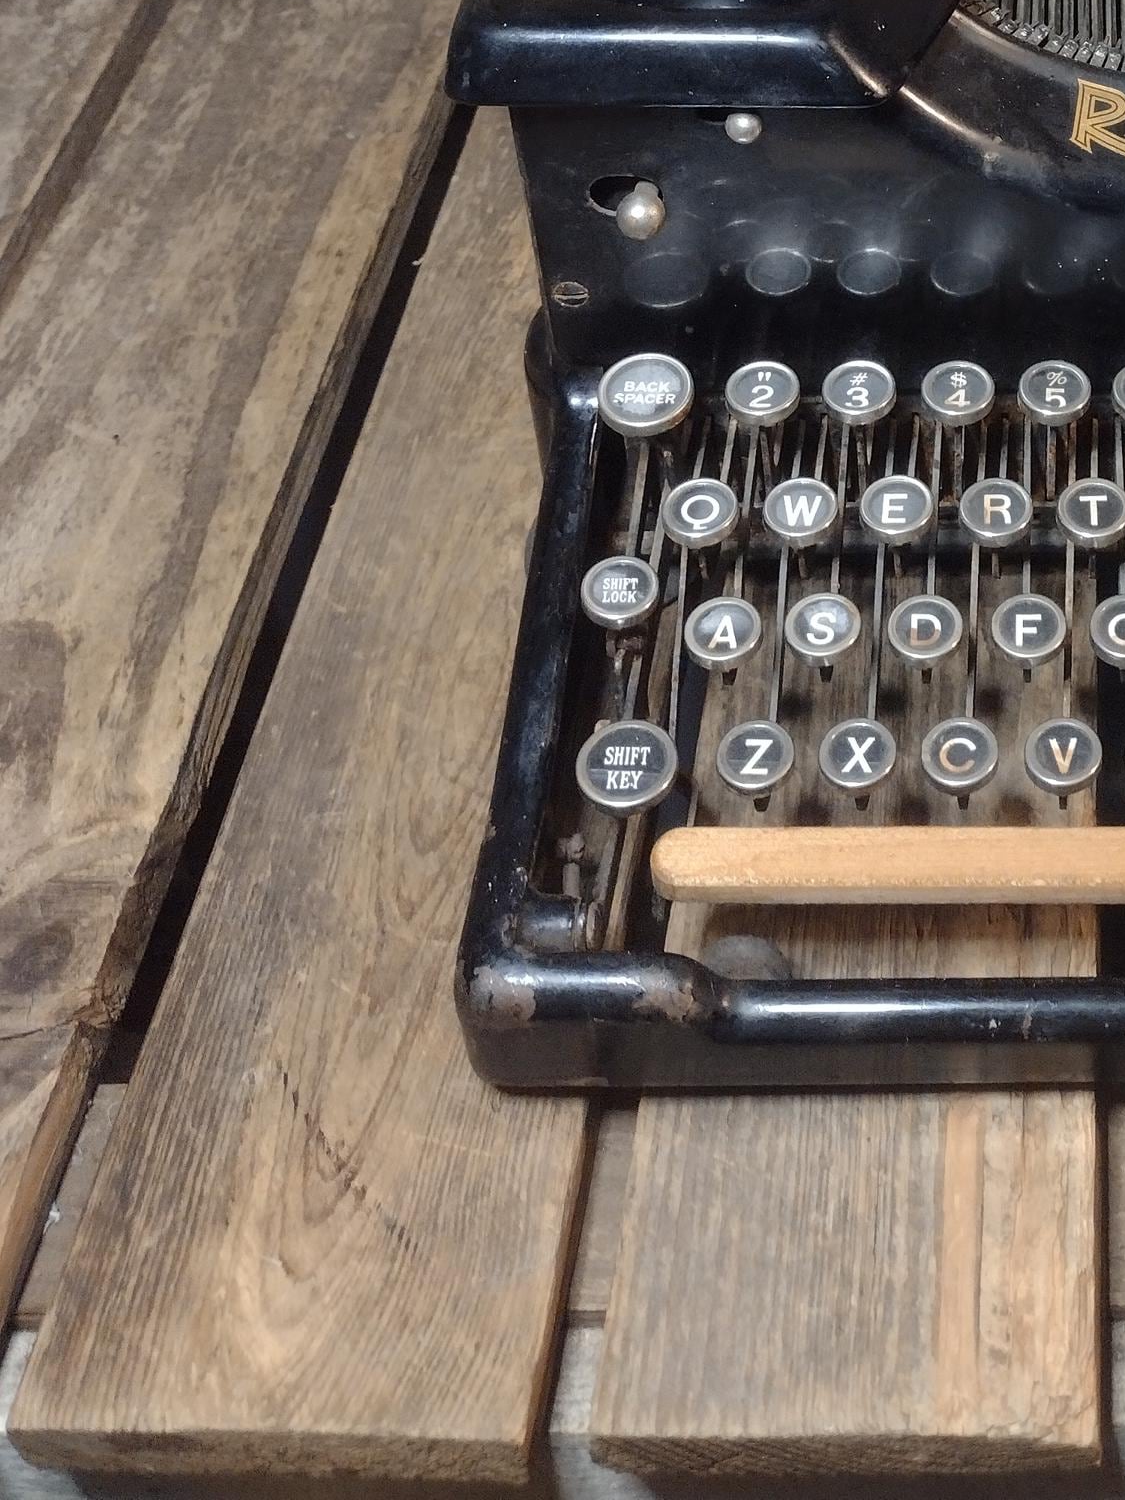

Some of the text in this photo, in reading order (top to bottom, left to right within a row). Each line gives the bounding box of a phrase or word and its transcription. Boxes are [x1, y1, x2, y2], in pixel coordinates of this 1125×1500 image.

[613, 392, 676, 405] SPACER
[624, 380, 670, 393] BACK
[749, 385, 775, 408] 2
[844, 387, 869, 407] 3
[944, 389, 971, 408] 4
[1045, 388, 1067, 408] 5
[681, 494, 720, 530] Q
[783, 495, 822, 526] W
[881, 493, 908, 524] E
[983, 494, 1012, 524] R
[1079, 495, 1108, 526] T
[602, 578, 639, 590] SHIFT
[602, 590, 637, 604] LOCK
[707, 615, 737, 649] A
[806, 612, 837, 645] S
[909, 613, 941, 646] D
[1014, 613, 1042, 647] F
[603, 745, 652, 766] SHIFT
[739, 739, 774, 775] Z
[841, 736, 876, 773] X
[939, 737, 977, 772] C
[1048, 737, 1078, 774] V
[605, 770, 644, 791] KEY
